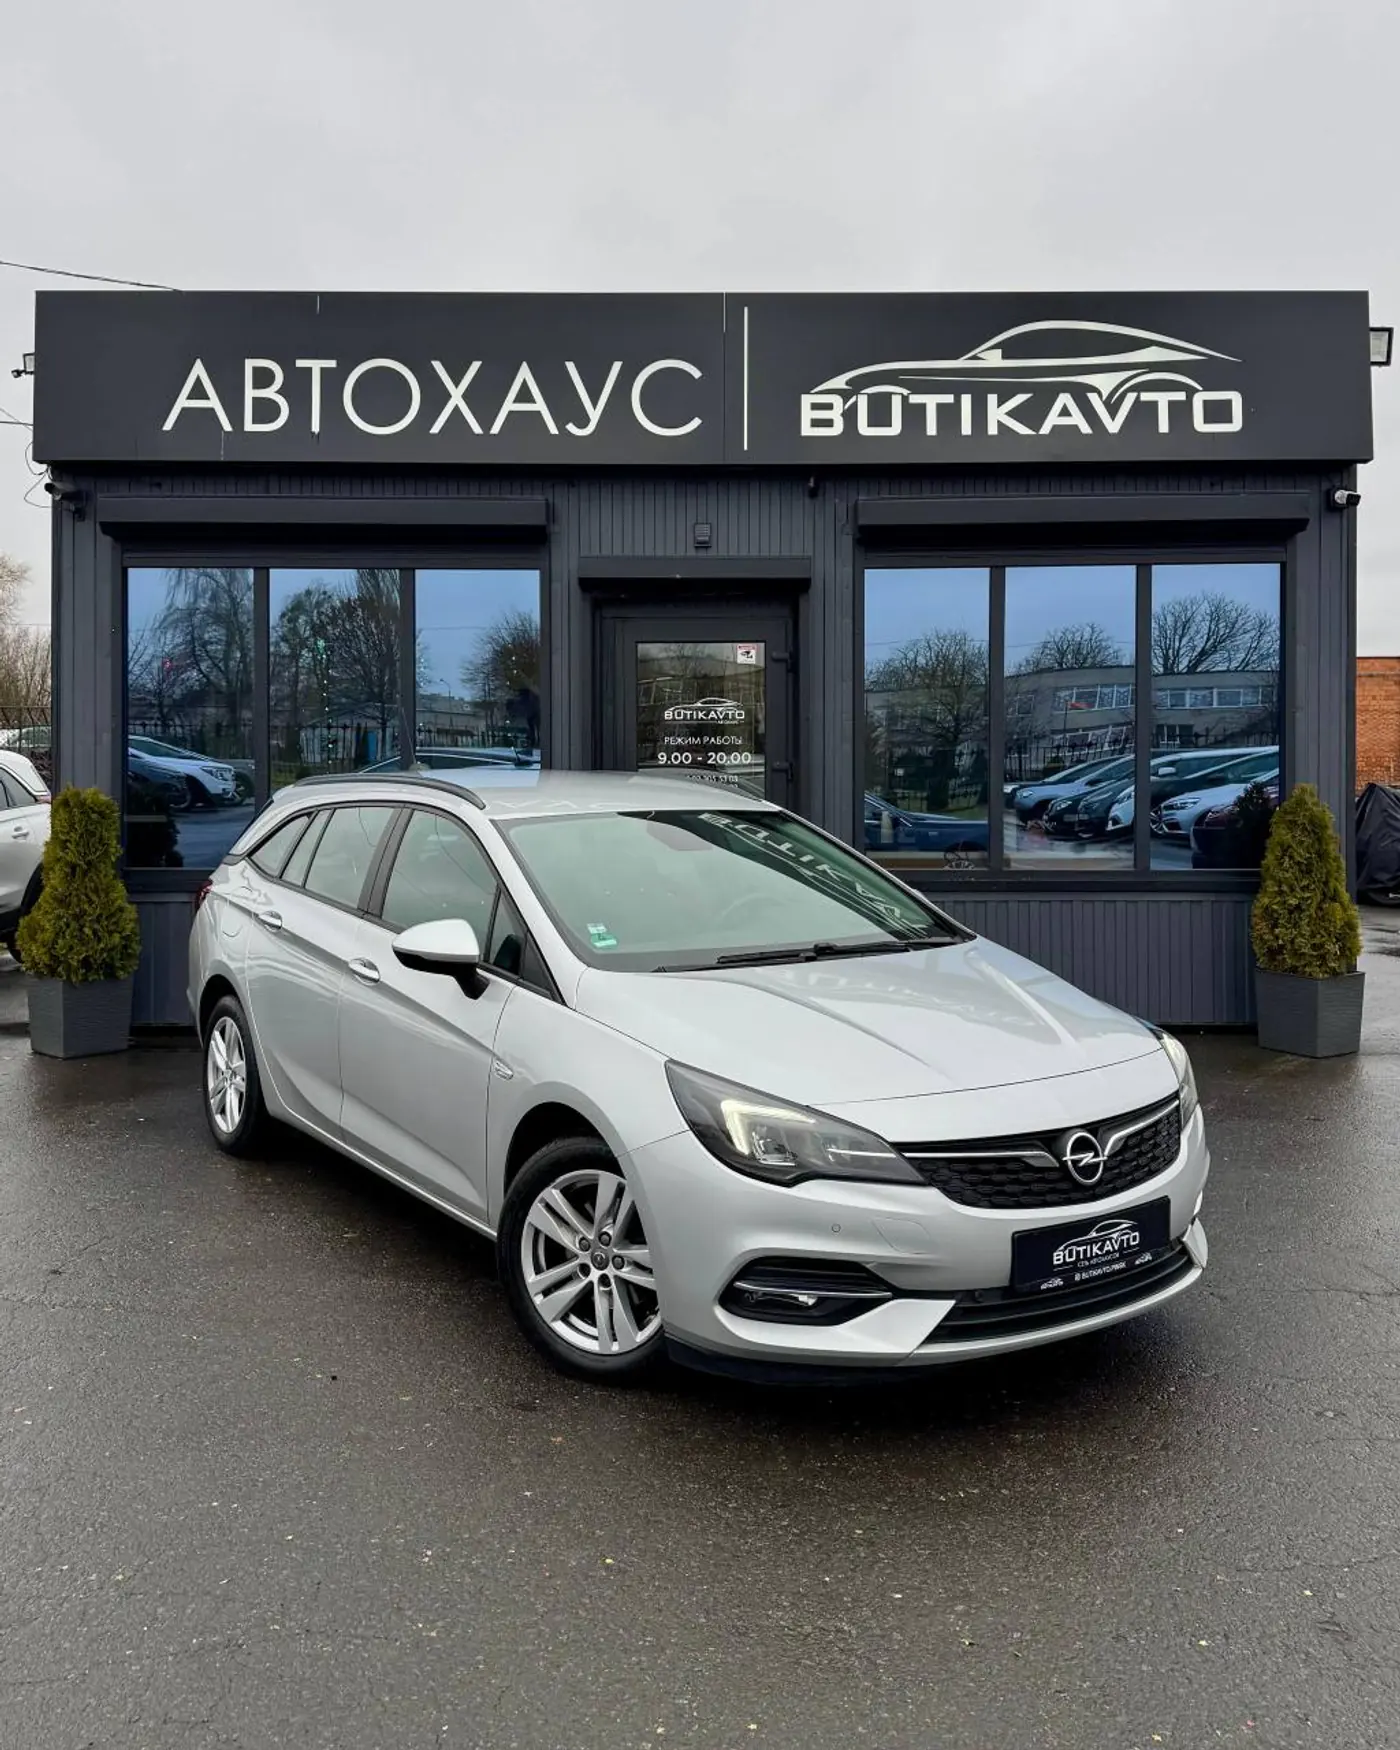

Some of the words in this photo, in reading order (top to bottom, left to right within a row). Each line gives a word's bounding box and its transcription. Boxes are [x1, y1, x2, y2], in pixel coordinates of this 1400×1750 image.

[162, 358, 702, 436] АВТОХАУС
[800, 390, 1243, 437] BUTIKAVTO
[664, 710, 745, 720] BUTIKAVTO
[664, 736, 701, 745] РЕЖИМ
[702, 736, 743, 745] РАБОТЫ
[657, 752, 692, 765] 9.00
[707, 752, 752, 765] 20.00
[1053, 1231, 1140, 1265] BUTIKAVTO
